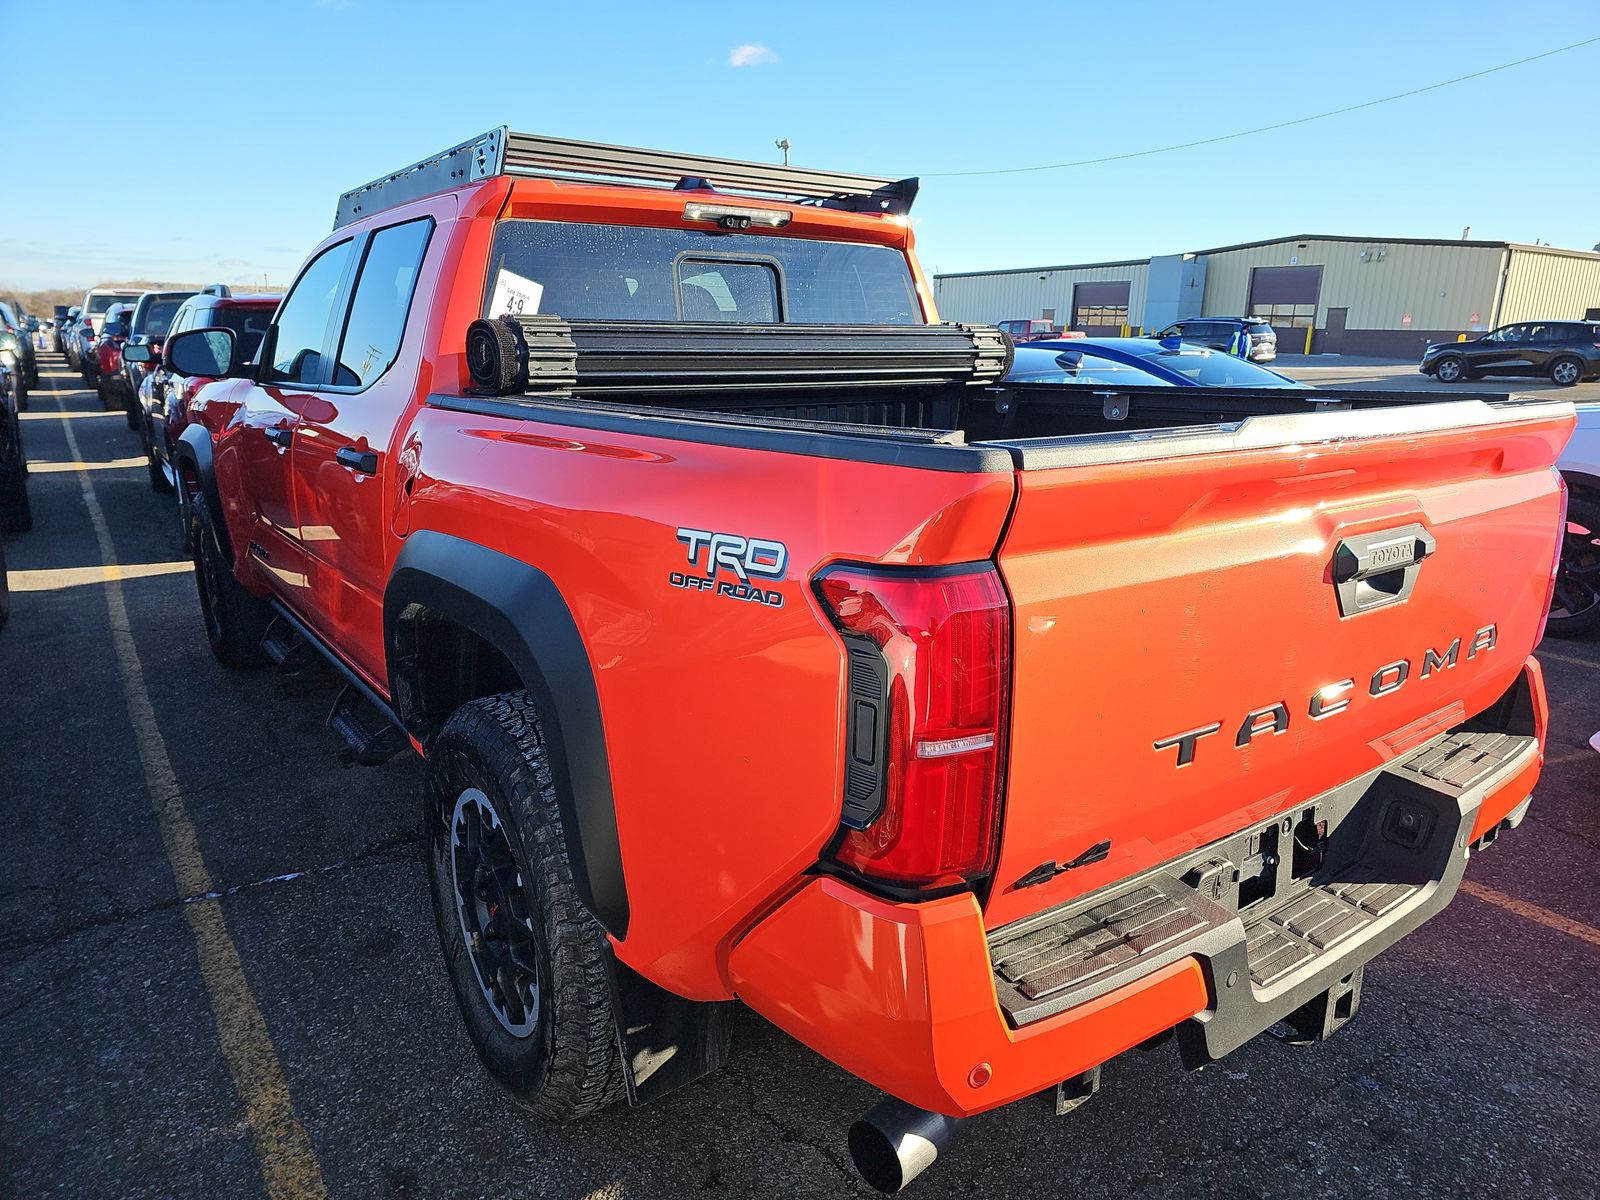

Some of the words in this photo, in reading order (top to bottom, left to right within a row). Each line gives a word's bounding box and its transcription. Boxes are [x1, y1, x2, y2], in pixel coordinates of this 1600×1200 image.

[676, 526, 789, 585] TRD
[1371, 543, 1413, 566] TOYOTA
[669, 571, 715, 592] OFF
[717, 581, 785, 608] ROAD
[1152, 622, 1499, 769] TACOMA
